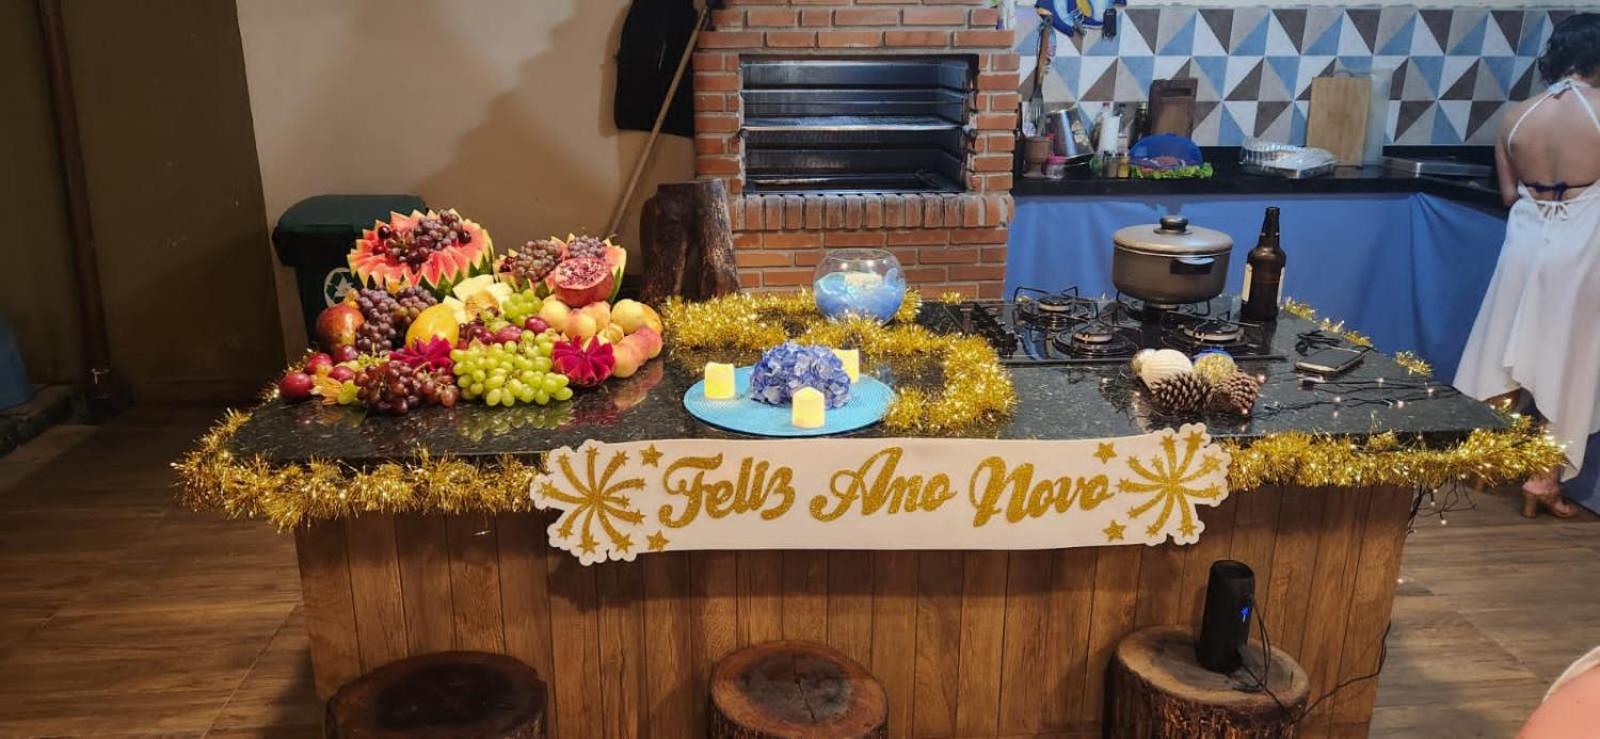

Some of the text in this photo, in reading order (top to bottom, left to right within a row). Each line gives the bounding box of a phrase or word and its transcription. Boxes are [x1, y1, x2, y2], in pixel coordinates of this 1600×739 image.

[658, 447, 1114, 528] Feliz Ano Novo
